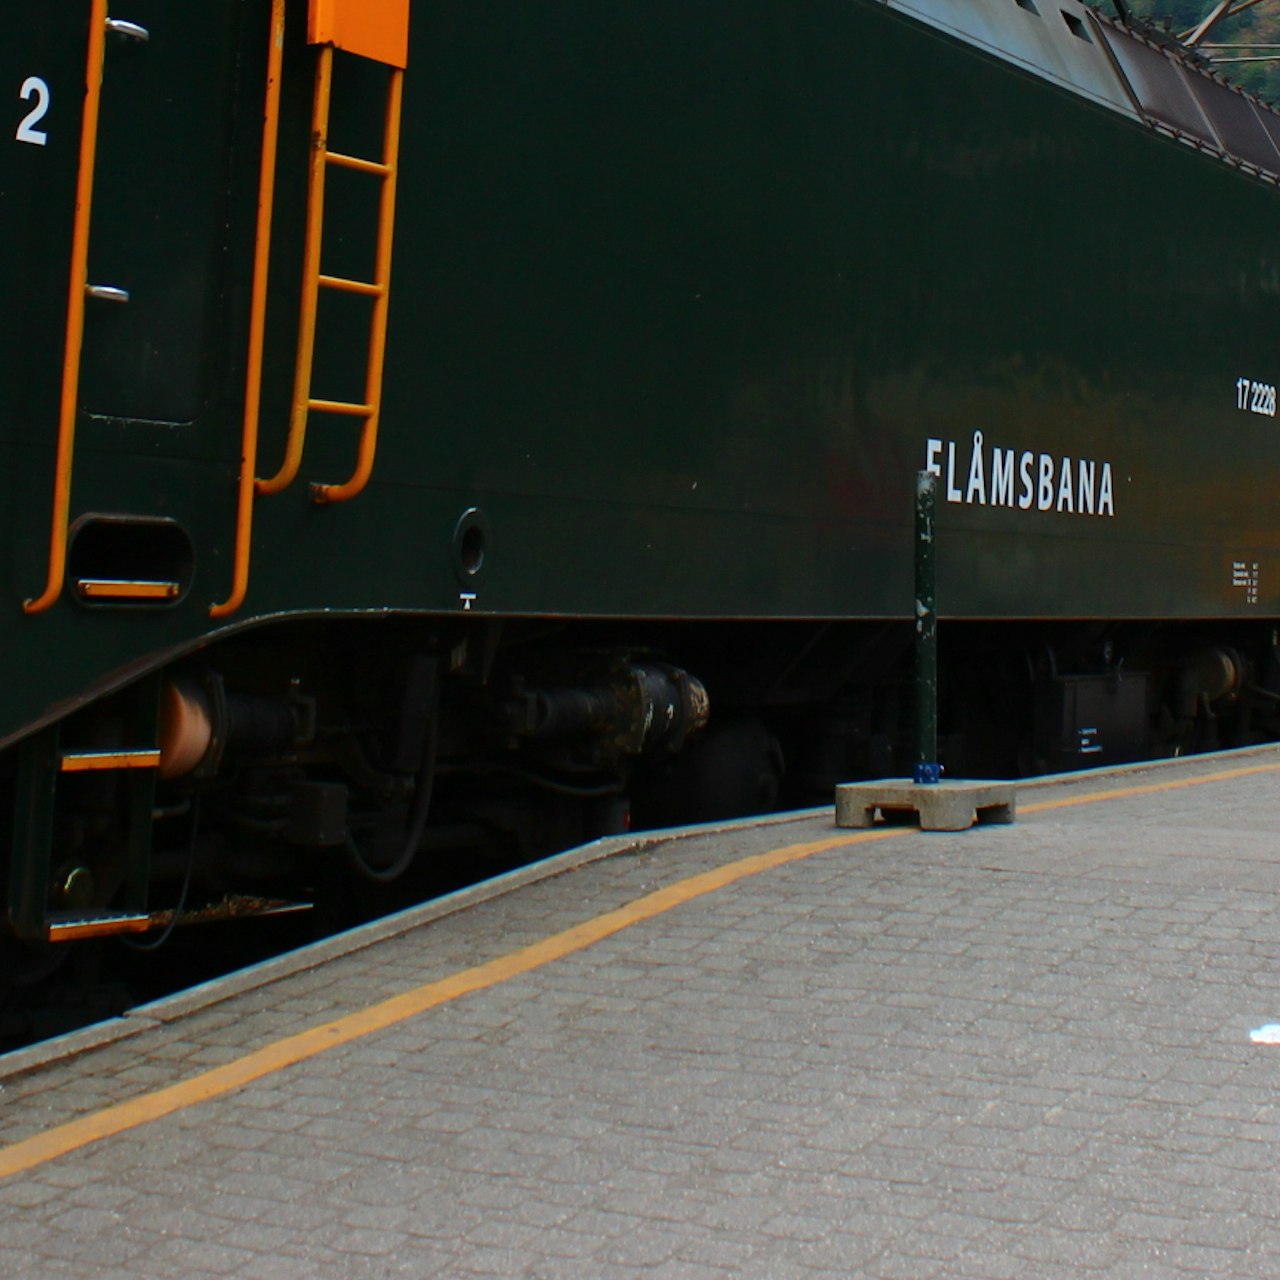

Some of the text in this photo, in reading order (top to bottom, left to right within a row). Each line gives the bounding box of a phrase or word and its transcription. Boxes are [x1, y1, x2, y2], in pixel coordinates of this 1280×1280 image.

[16, 76, 50, 146] 2
[1236, 377, 1277, 417] 17 2228
